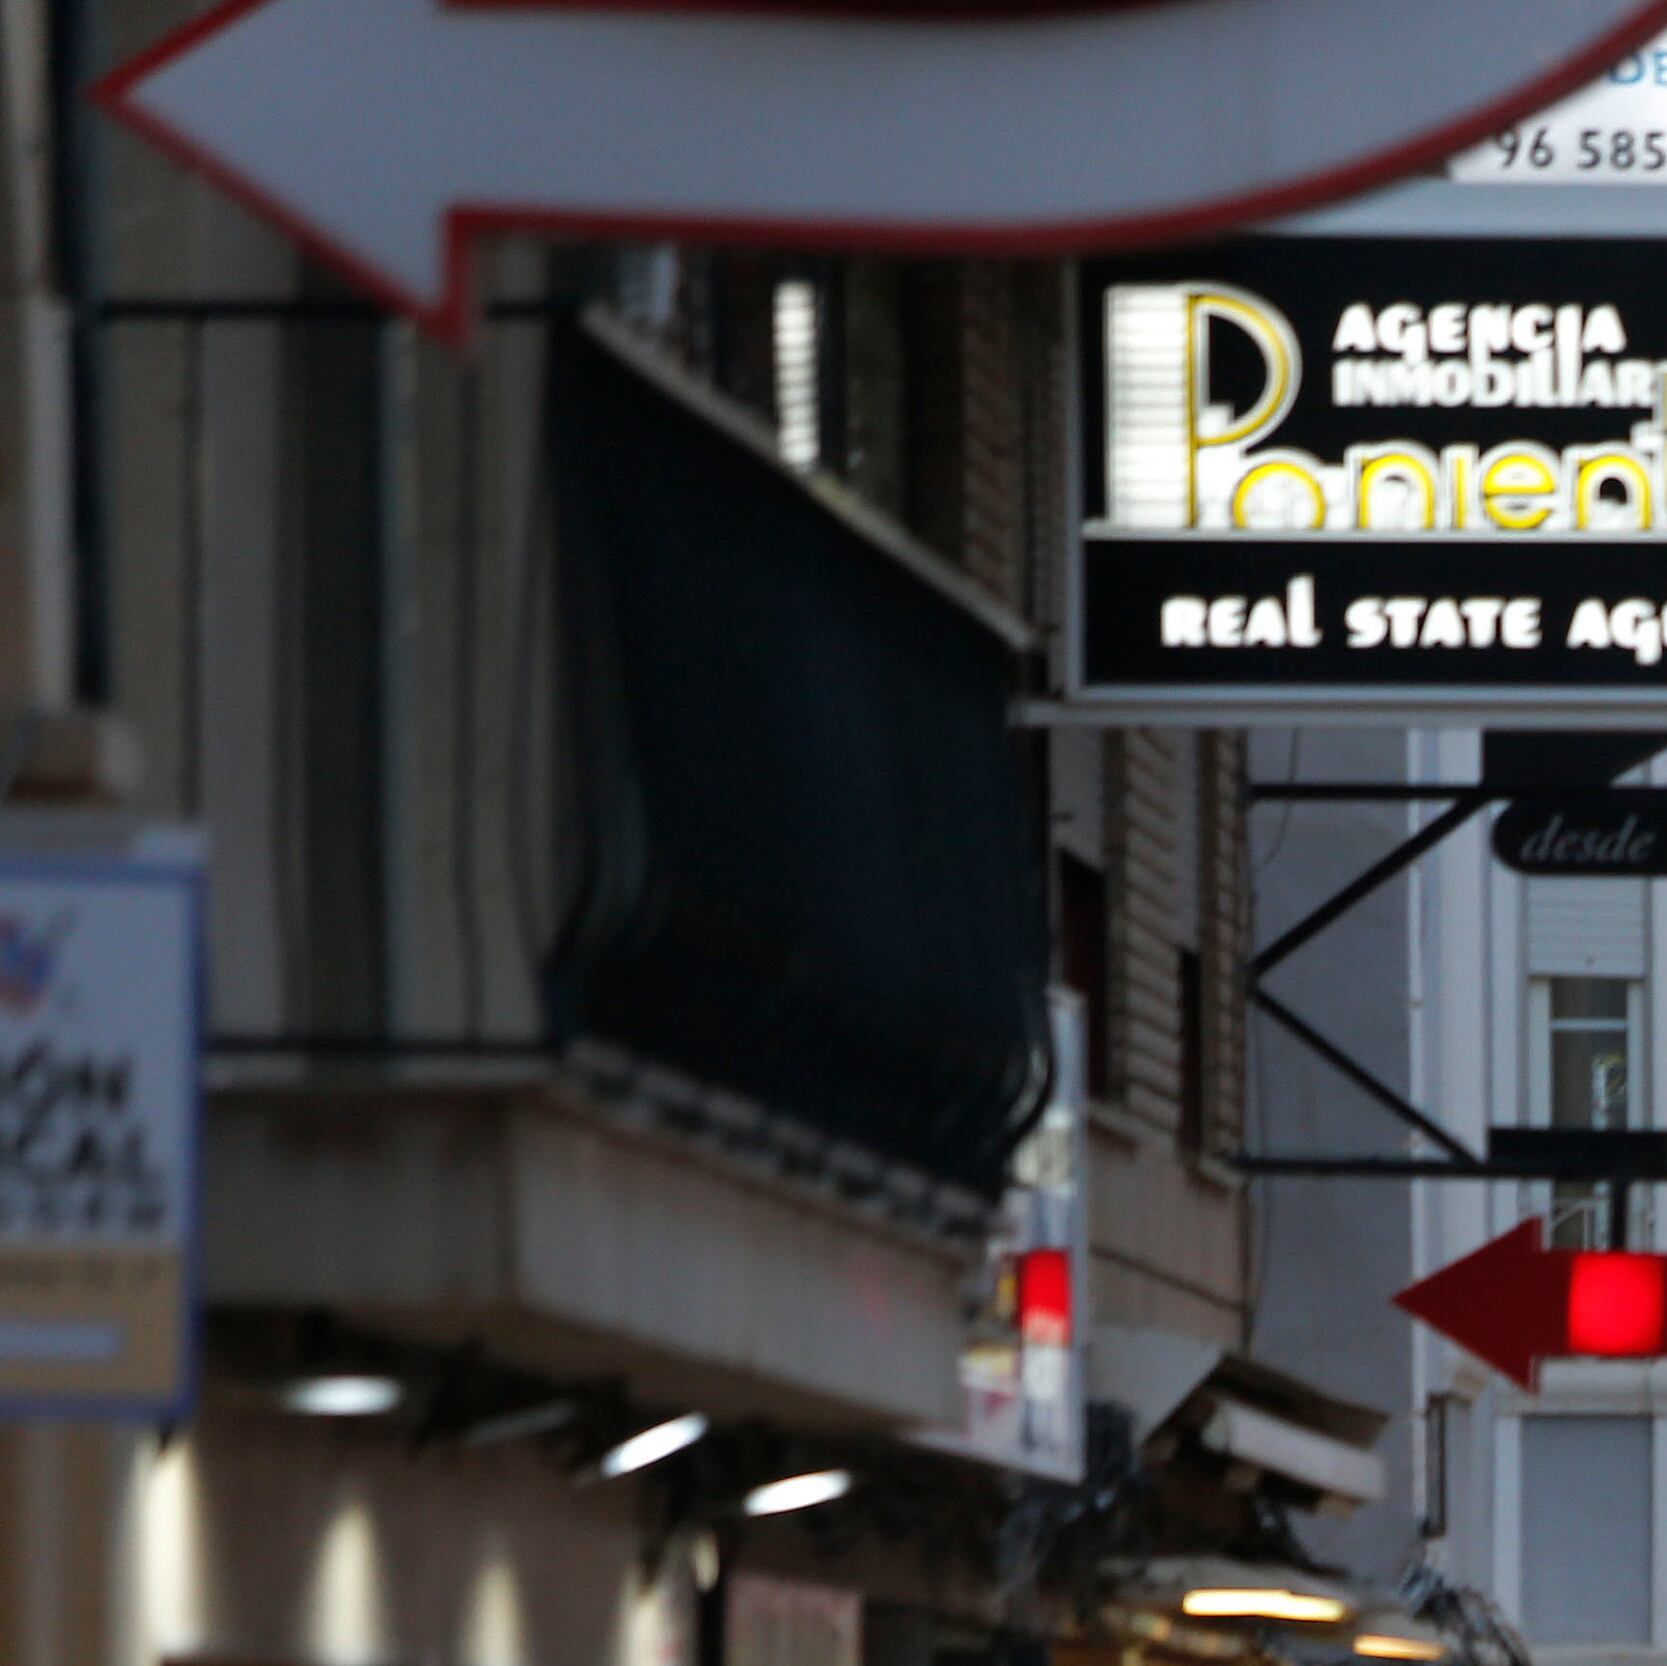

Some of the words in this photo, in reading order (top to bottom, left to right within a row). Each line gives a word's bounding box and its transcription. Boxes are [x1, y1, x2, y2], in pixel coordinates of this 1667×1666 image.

[1500, 127, 1554, 169] 96
[1577, 129, 1667, 171] 585
[1332, 302, 1627, 360] AGENCIA
[1160, 577, 1321, 648] REAL
[1345, 597, 1541, 648] STATE
[1520, 814, 1656, 863] desde
